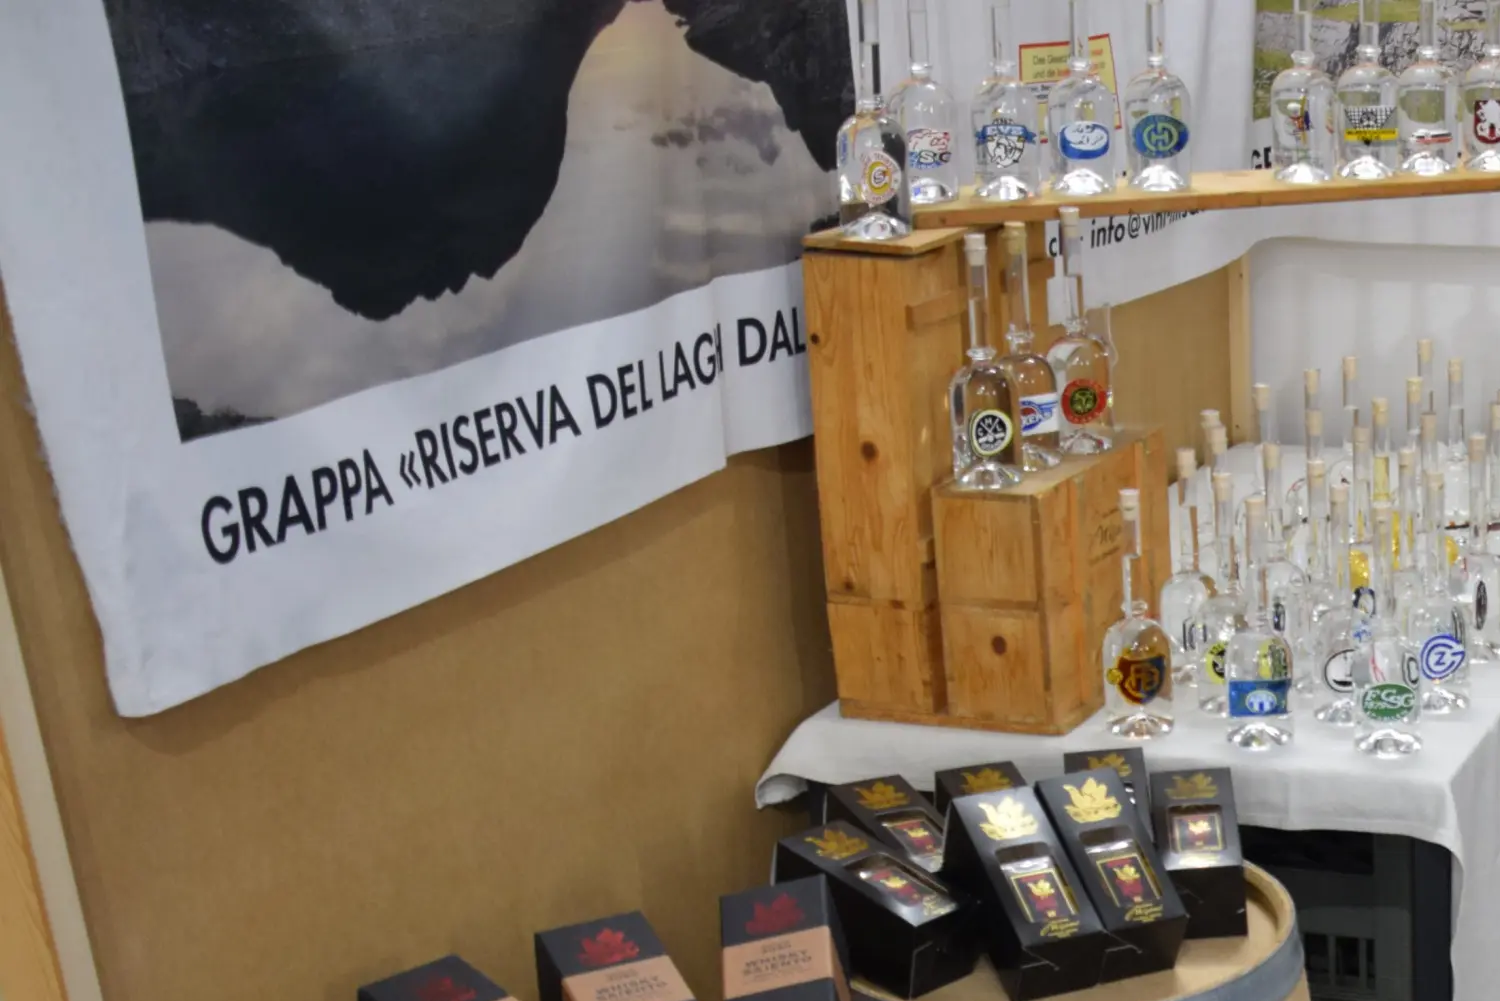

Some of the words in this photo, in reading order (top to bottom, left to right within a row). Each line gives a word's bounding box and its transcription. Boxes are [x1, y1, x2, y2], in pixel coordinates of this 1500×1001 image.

[201, 448, 394, 564] GRAPPA
[400, 384, 582, 489] «RISERVA
[586, 359, 653, 430] DEL
